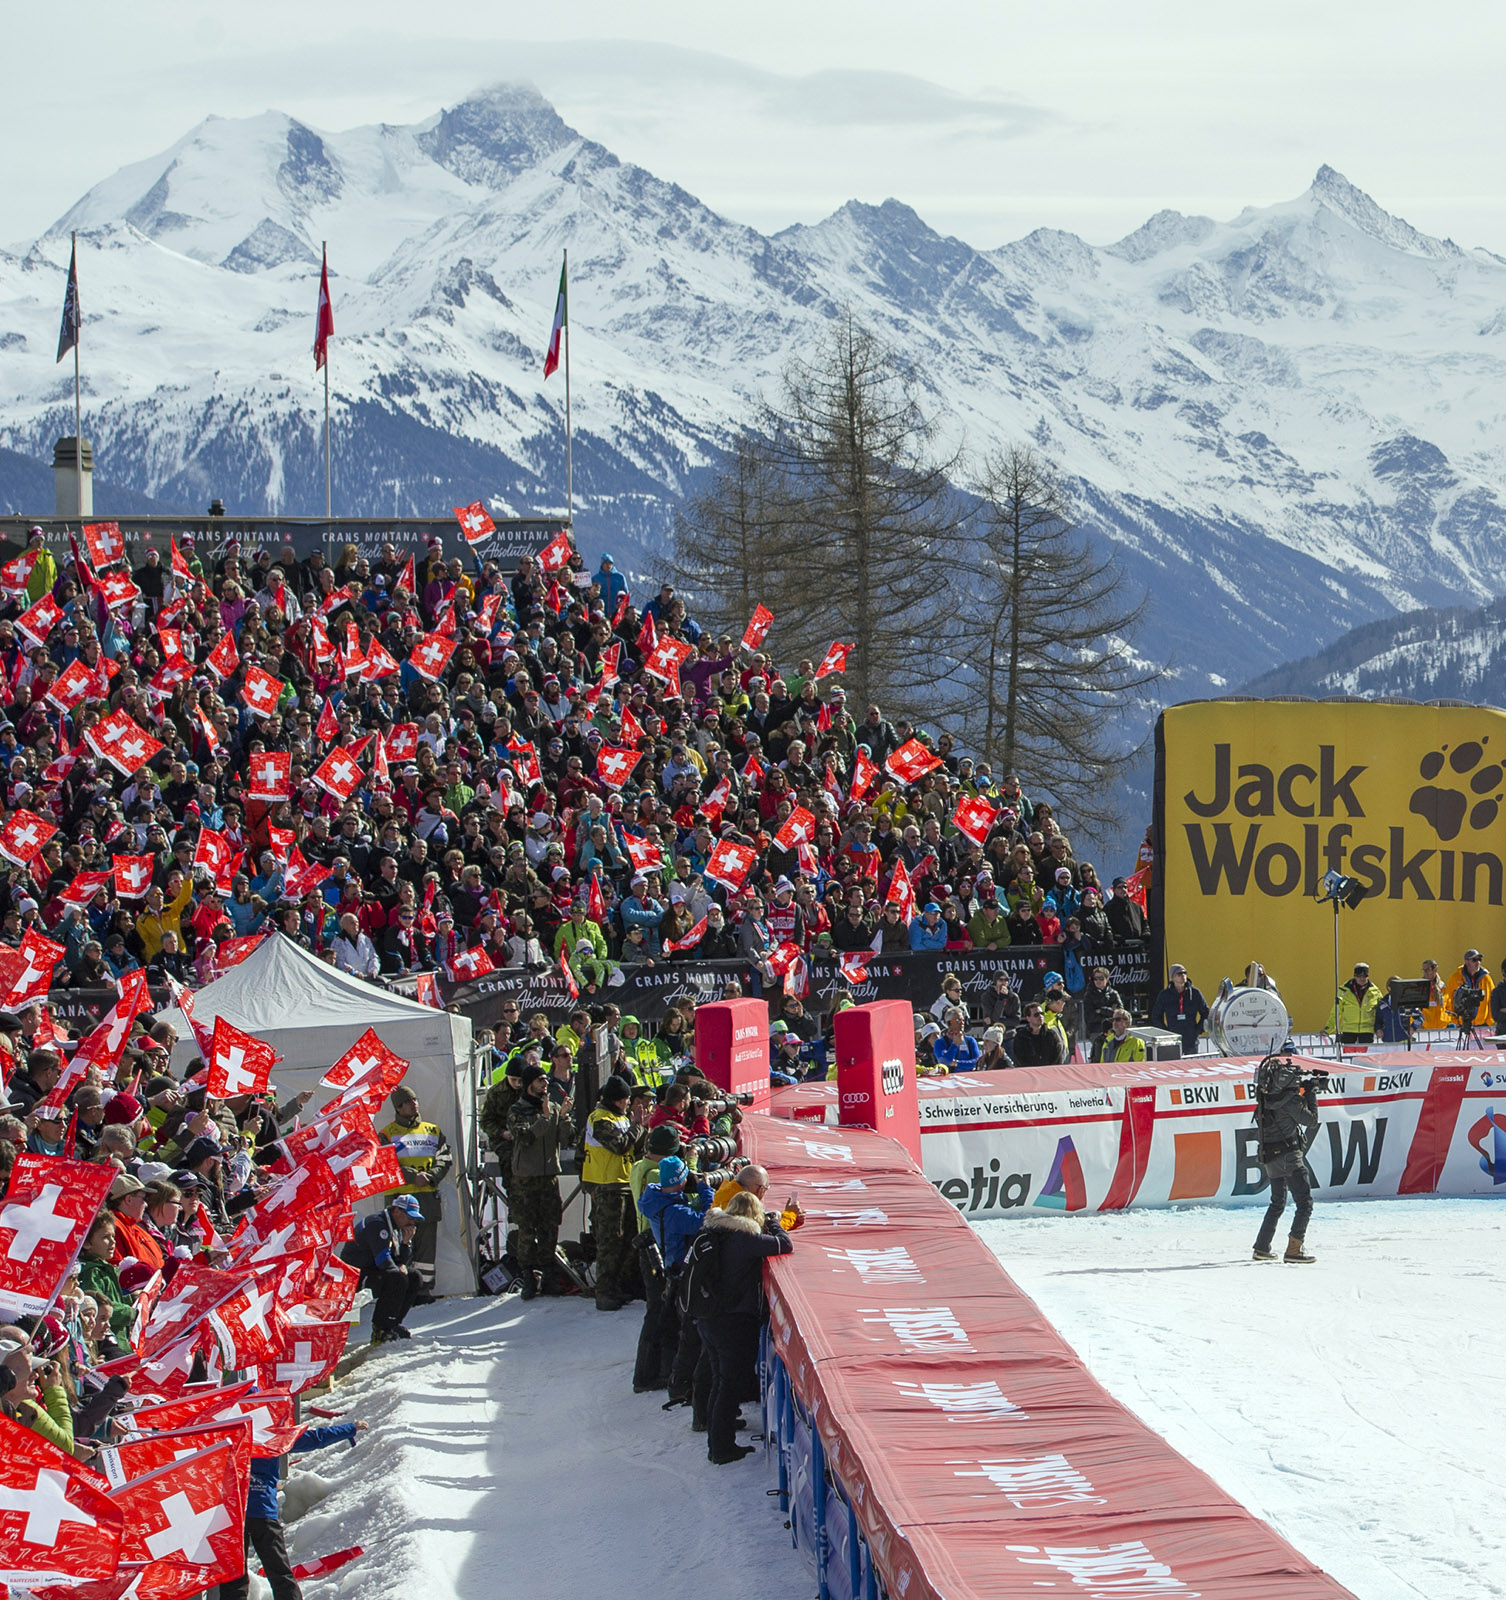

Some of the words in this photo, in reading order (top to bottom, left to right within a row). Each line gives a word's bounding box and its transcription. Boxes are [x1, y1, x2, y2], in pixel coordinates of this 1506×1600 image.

[225, 531, 280, 543] MONTANA
[322, 532, 359, 542] CRANS
[365, 532, 418, 542] MONTANA
[497, 531, 549, 541] MONTANA
[478, 541, 537, 558] Absolutely
[1183, 743, 1369, 819] Jack
[1182, 823, 1505, 906] Wolfskin
[937, 960, 976, 972] CRANS
[980, 958, 1035, 971] MONTANA
[1080, 955, 1114, 967] CRANS
[478, 979, 524, 993] CRANS
[635, 972, 680, 988] CRANS
[685, 971, 741, 985] MONTANA
[515, 988, 578, 1013] Absolutely
[1183, 1086, 1219, 1104] BKW
[1377, 1071, 1414, 1092] BKW
[925, 1102, 981, 1119] Schweizer
[984, 1098, 1058, 1116] Versicherung.
[1069, 1096, 1104, 1109] helvetia
